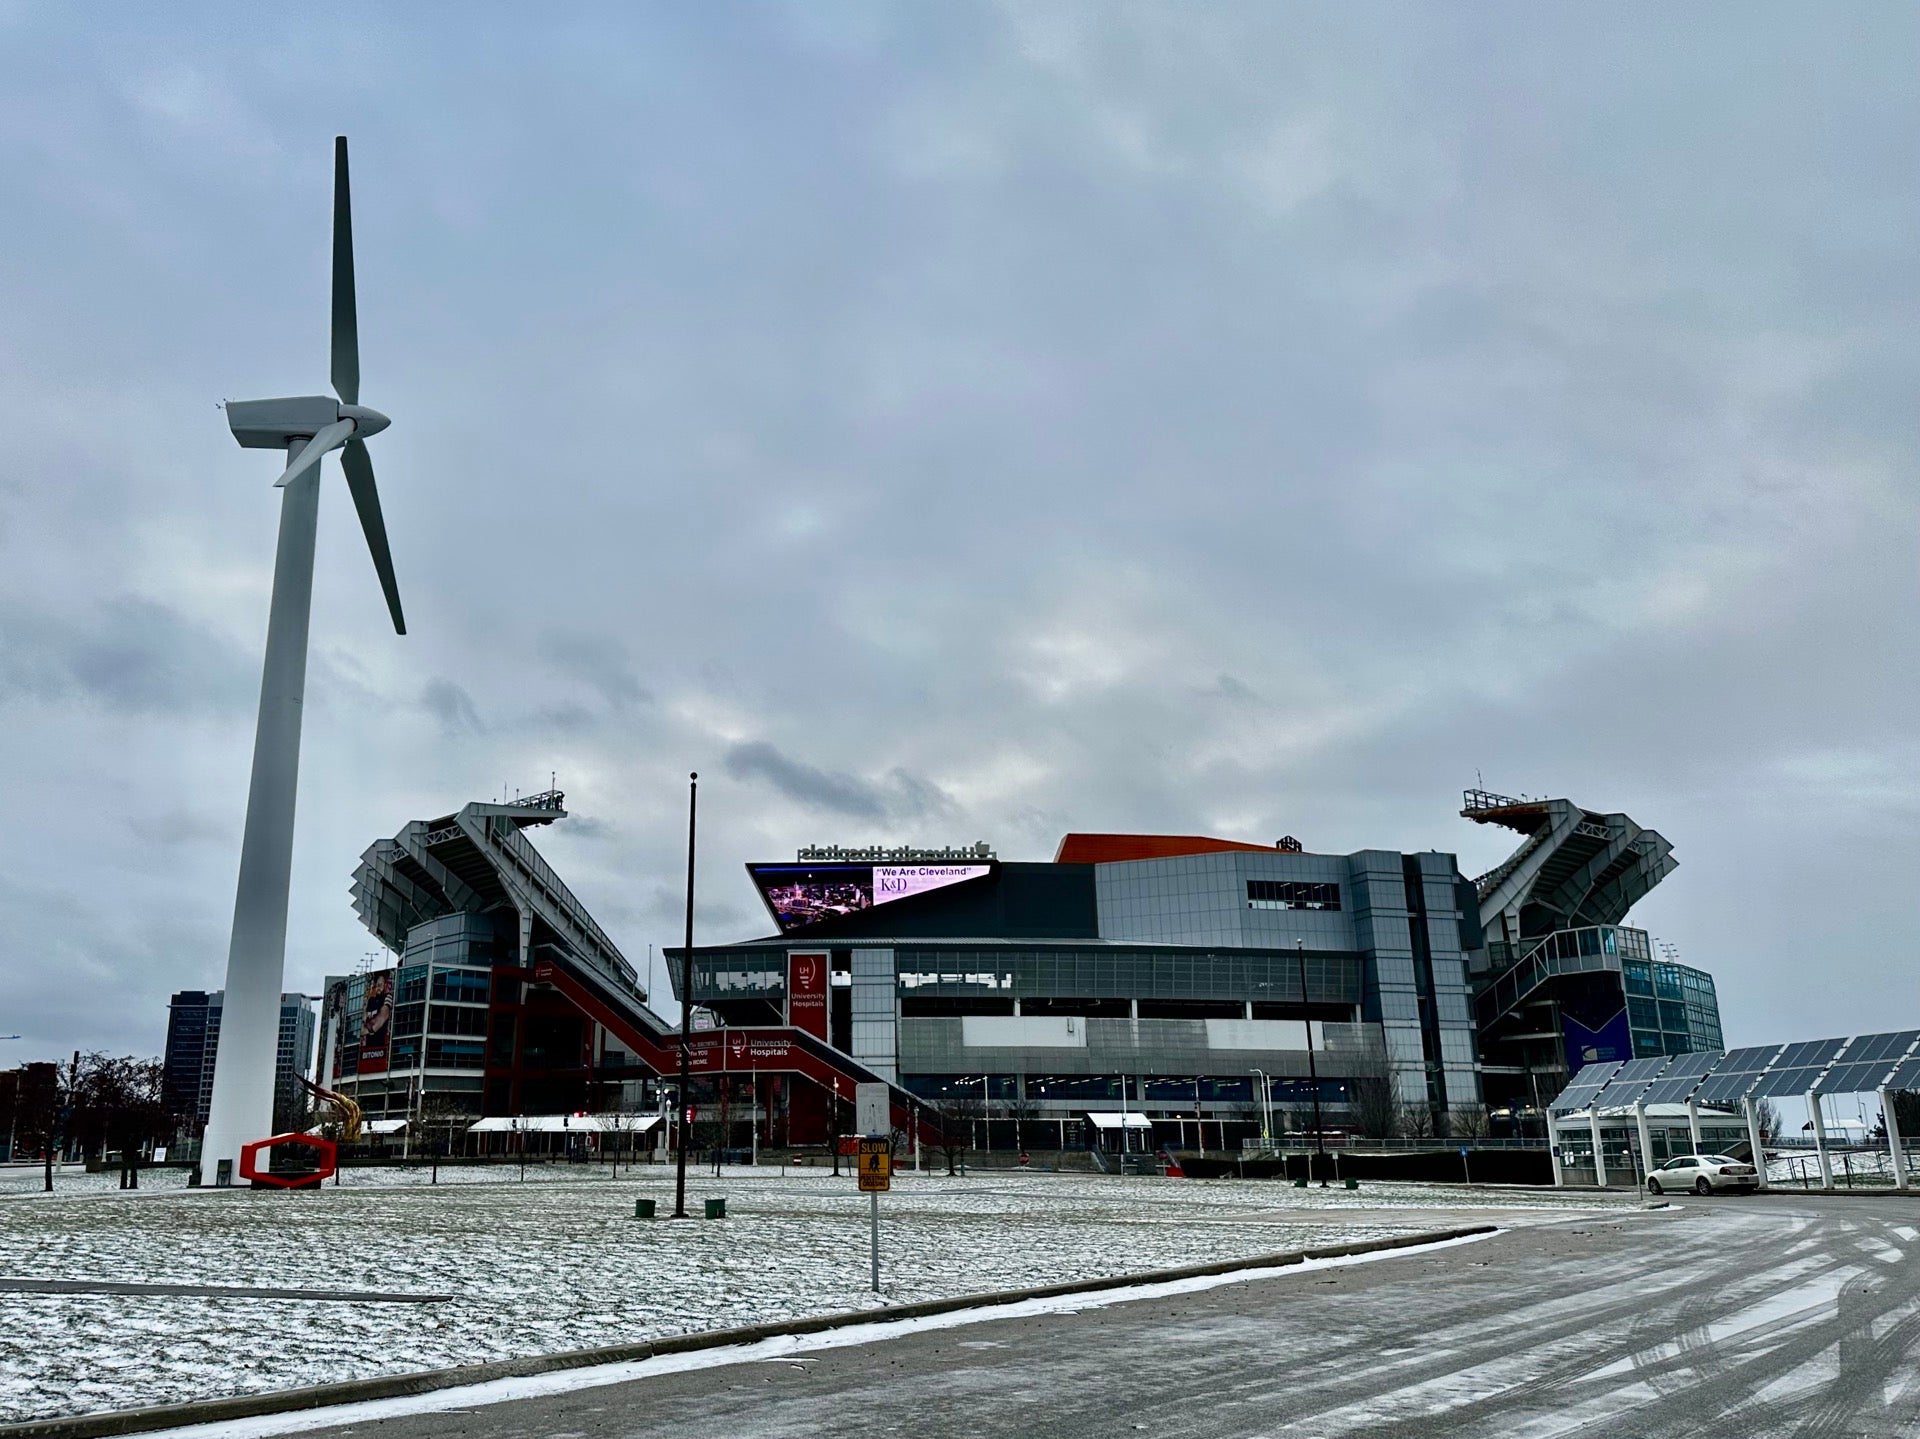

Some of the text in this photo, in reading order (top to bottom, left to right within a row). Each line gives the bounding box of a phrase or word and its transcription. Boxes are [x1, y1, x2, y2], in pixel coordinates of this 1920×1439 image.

[899, 867, 916, 876] Are
[881, 878, 907, 892] K&D
[799, 966, 809, 974] UH
[750, 1039, 792, 1048] University
[750, 1048, 788, 1057] Hospitals
[861, 1142, 887, 1153] SLOW
